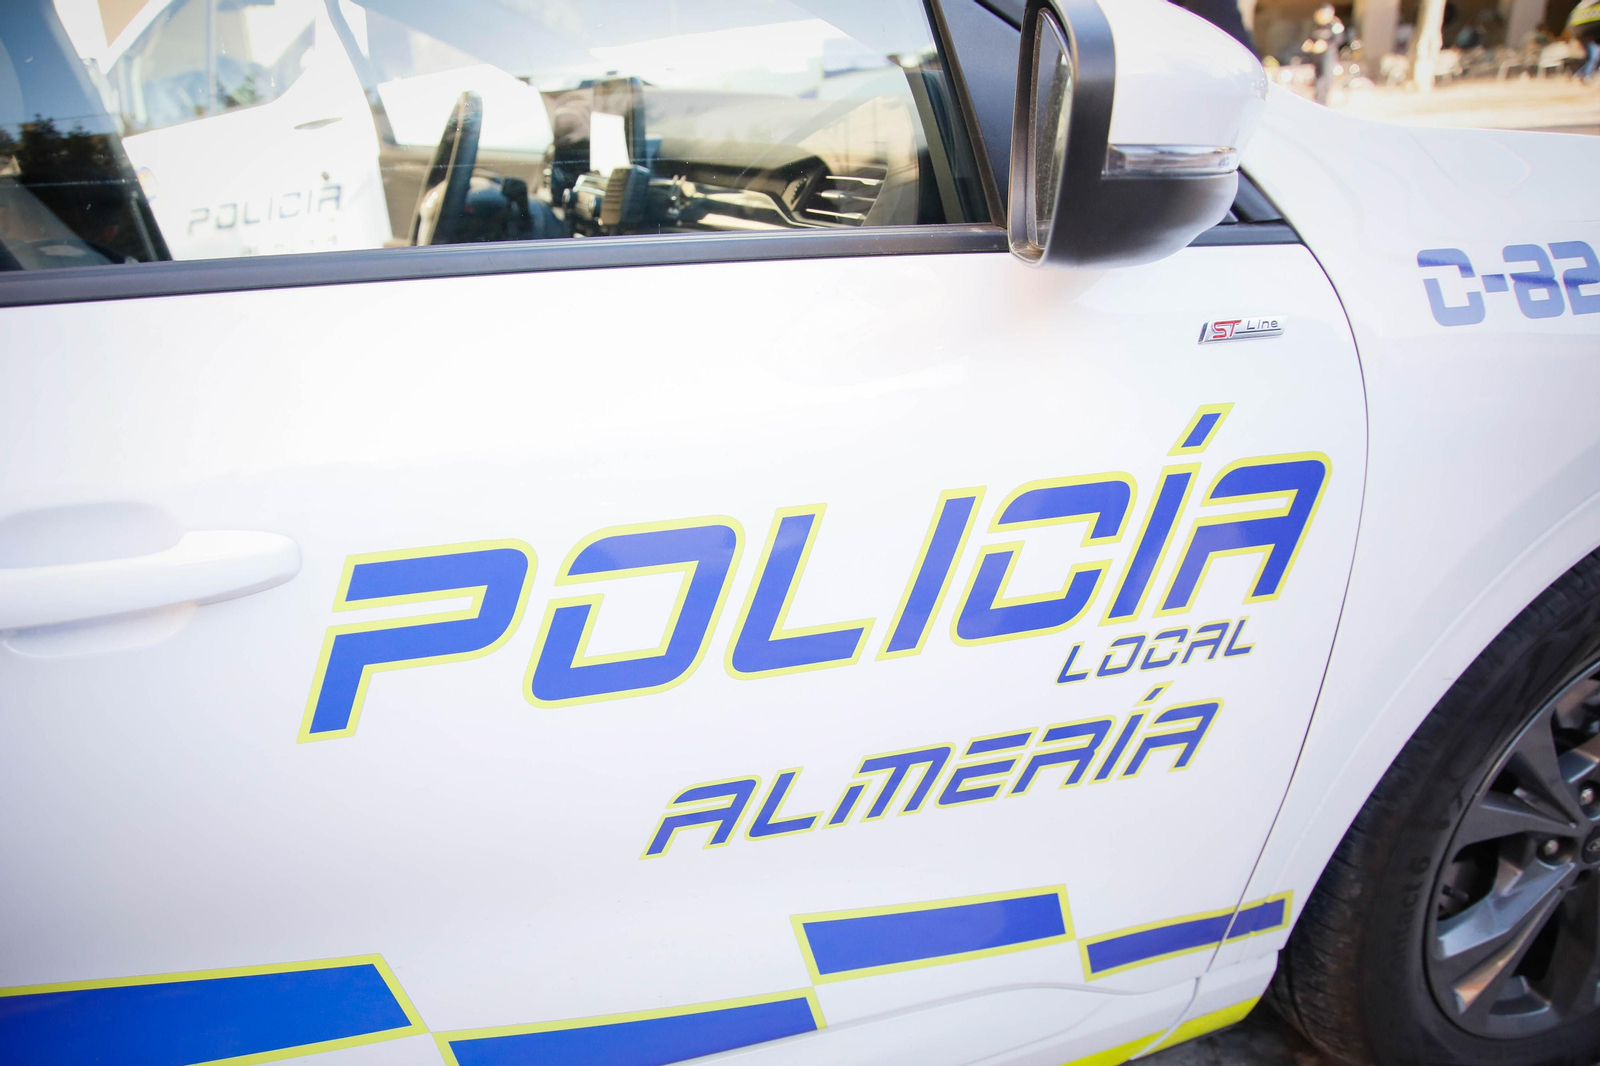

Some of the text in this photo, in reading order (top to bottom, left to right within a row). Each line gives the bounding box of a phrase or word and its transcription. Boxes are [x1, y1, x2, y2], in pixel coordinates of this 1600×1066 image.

[1417, 240, 1600, 327] C-82
[298, 404, 1332, 743] POLICÍA
[1056, 616, 1254, 684] LOCAL
[640, 682, 1224, 860] ALMERÍA
